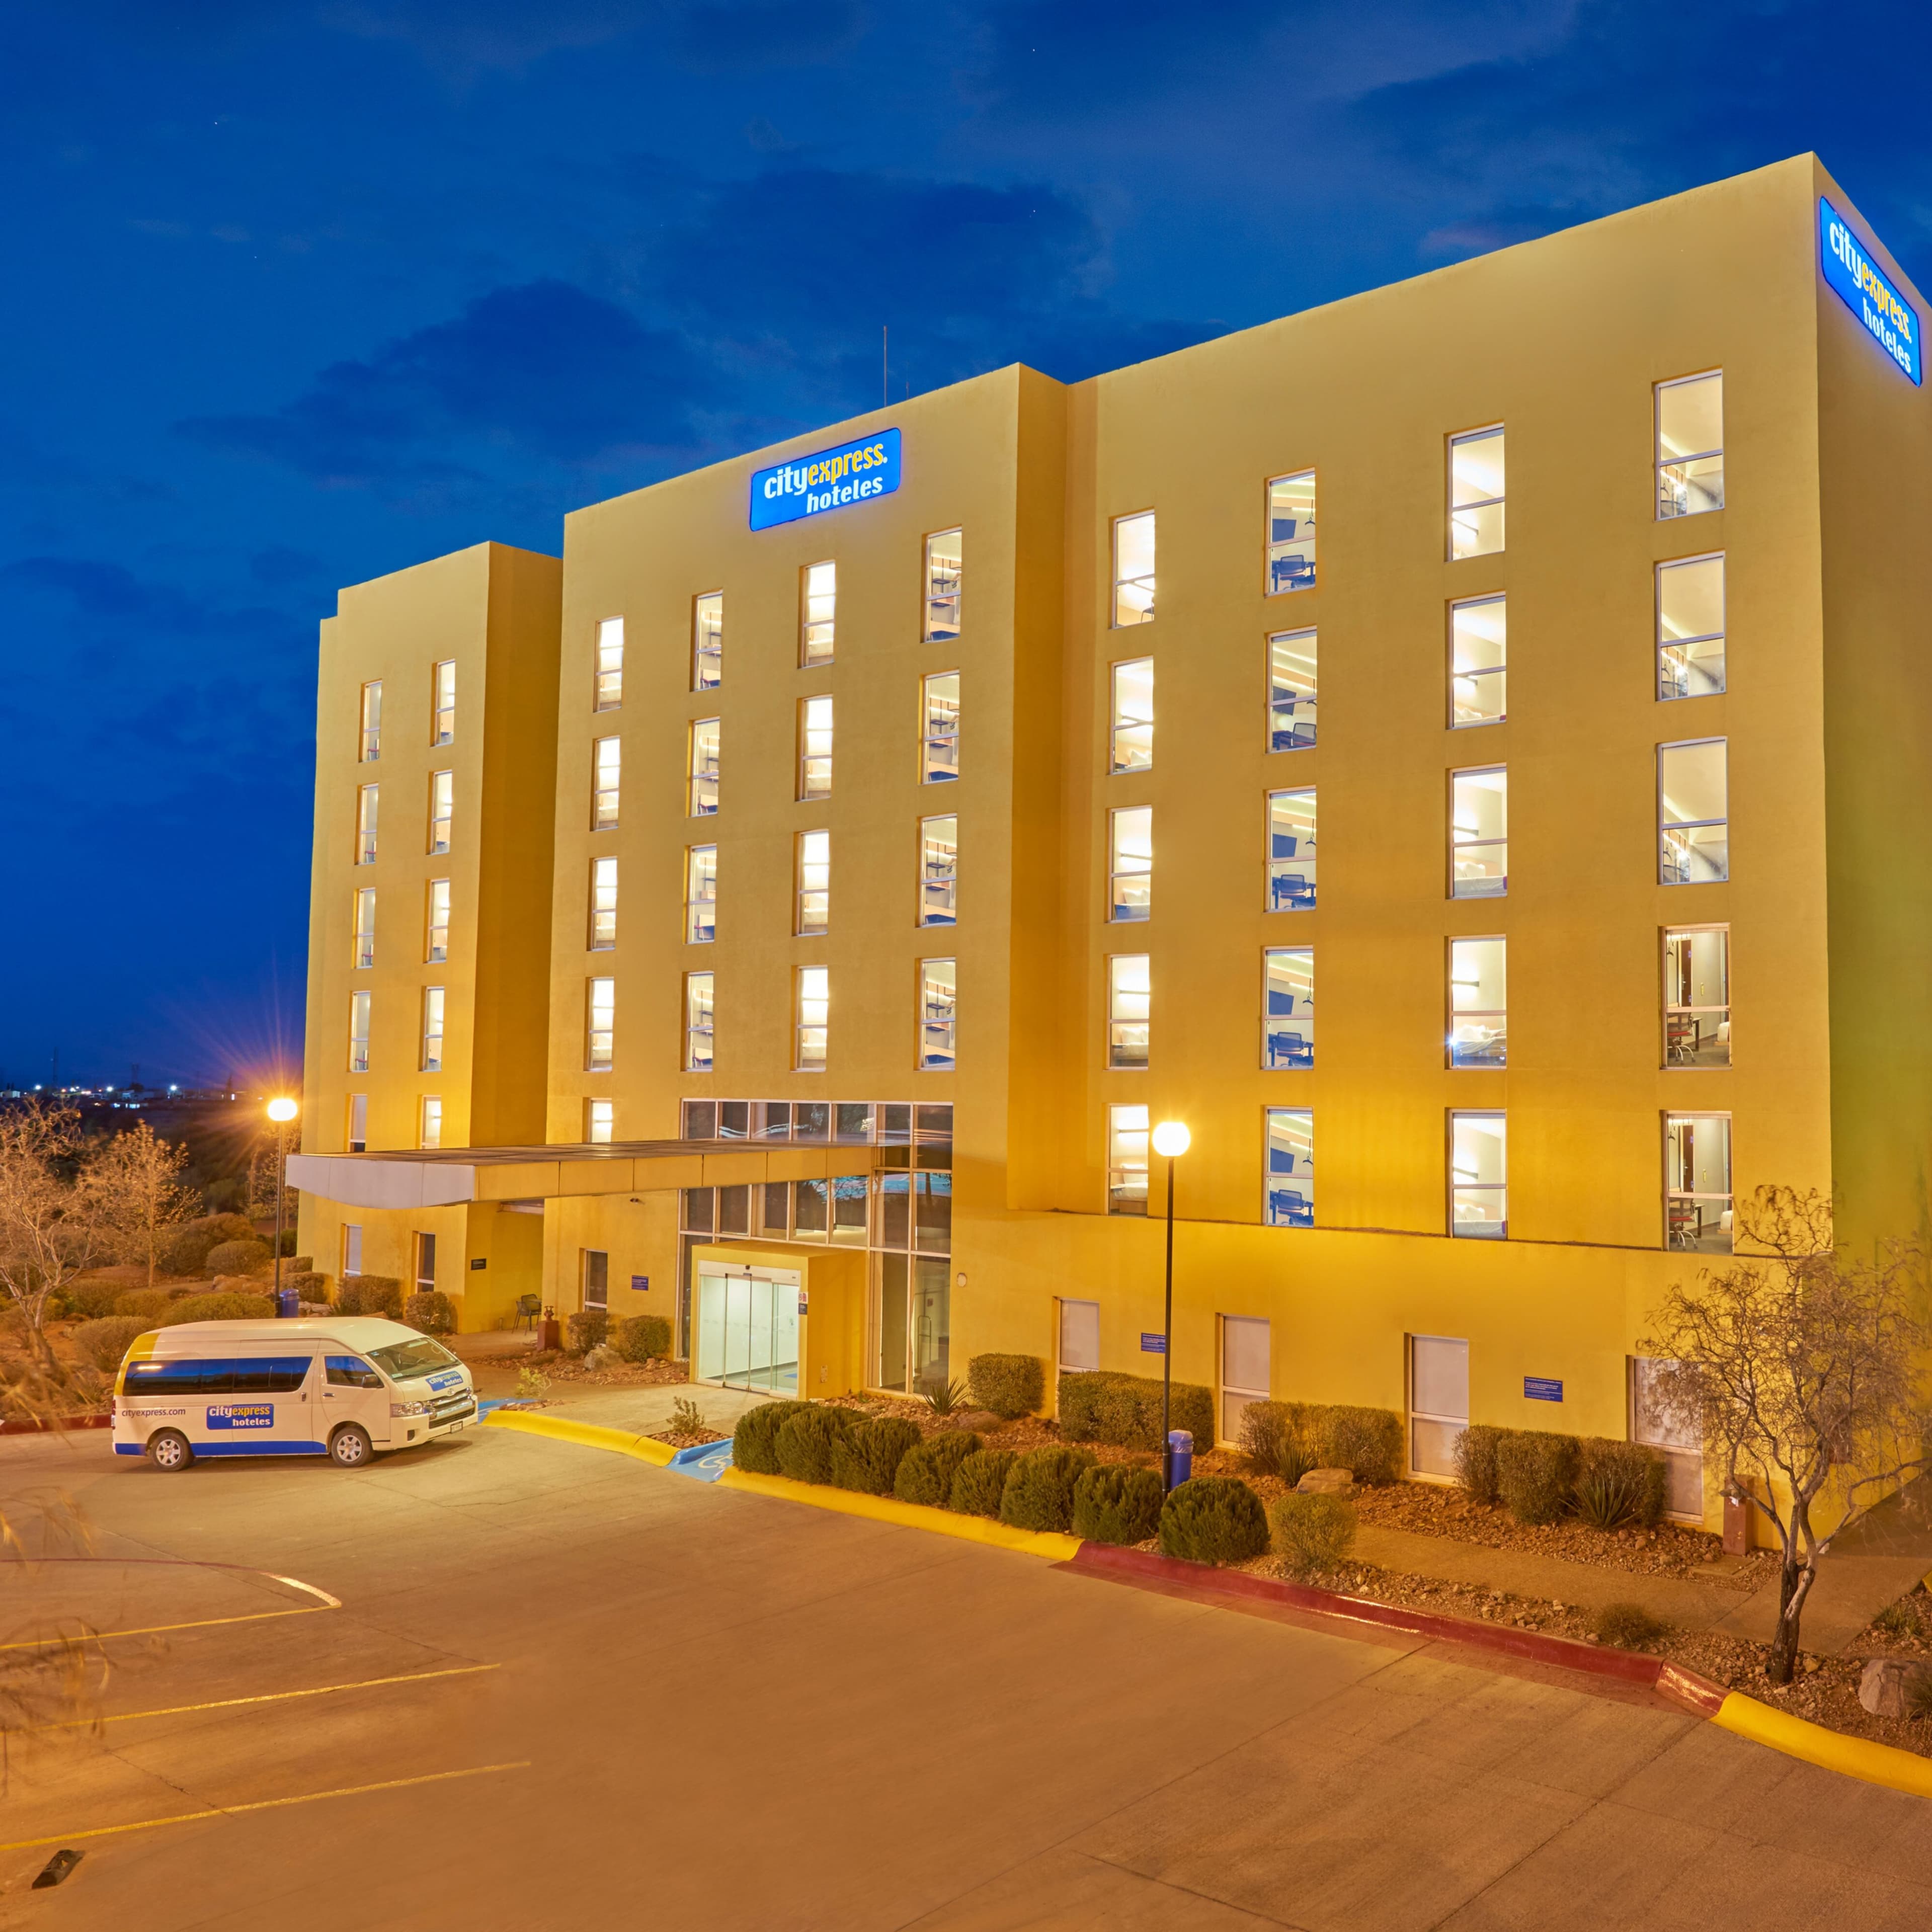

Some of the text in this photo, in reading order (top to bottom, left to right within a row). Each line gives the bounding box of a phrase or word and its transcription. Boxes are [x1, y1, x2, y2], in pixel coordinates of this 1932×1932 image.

[1863, 297, 1911, 374] hoteles
[806, 477, 883, 514] hoteles
[122, 1408, 186, 1419] cityexpress.com
[209, 1406, 270, 1418] cityexpress
[232, 1418, 270, 1426] hoteles
